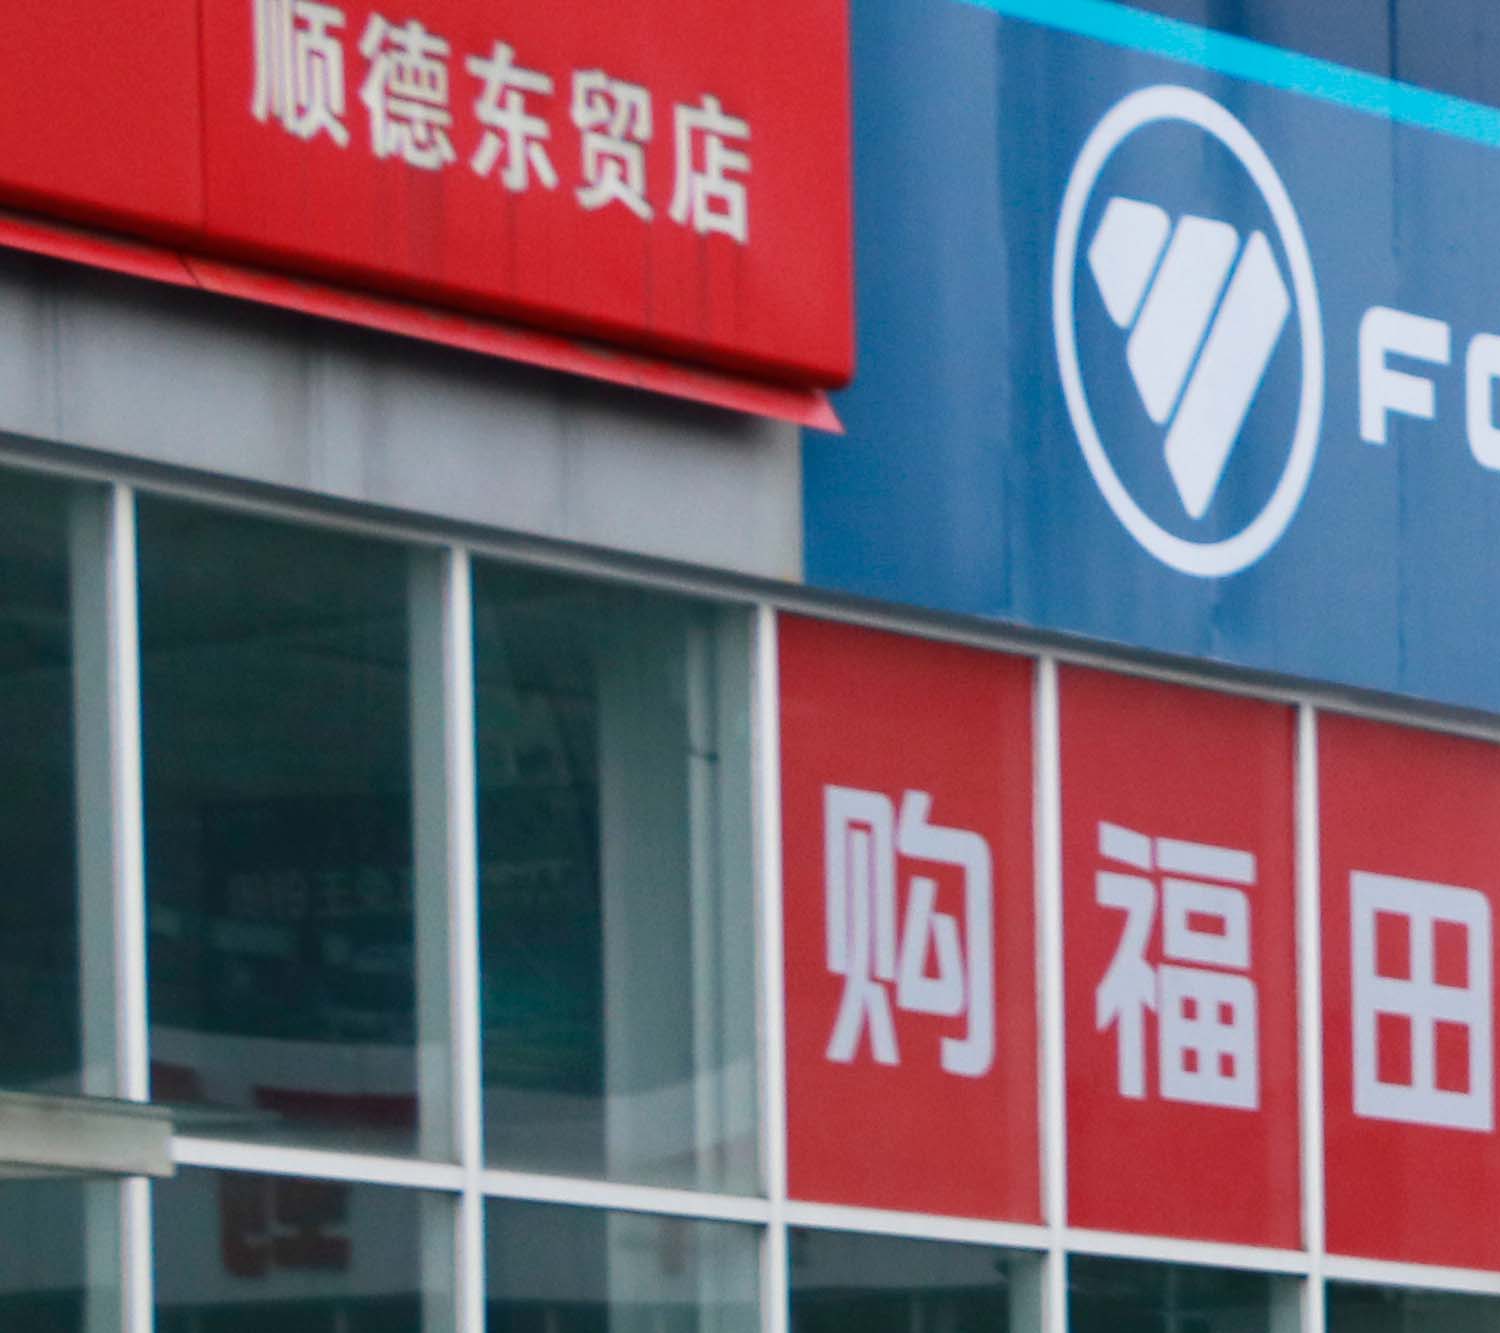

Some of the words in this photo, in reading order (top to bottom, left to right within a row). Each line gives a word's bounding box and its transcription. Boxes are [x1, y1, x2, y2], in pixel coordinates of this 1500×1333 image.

[252, 0, 753, 244] 顺德东贸店
